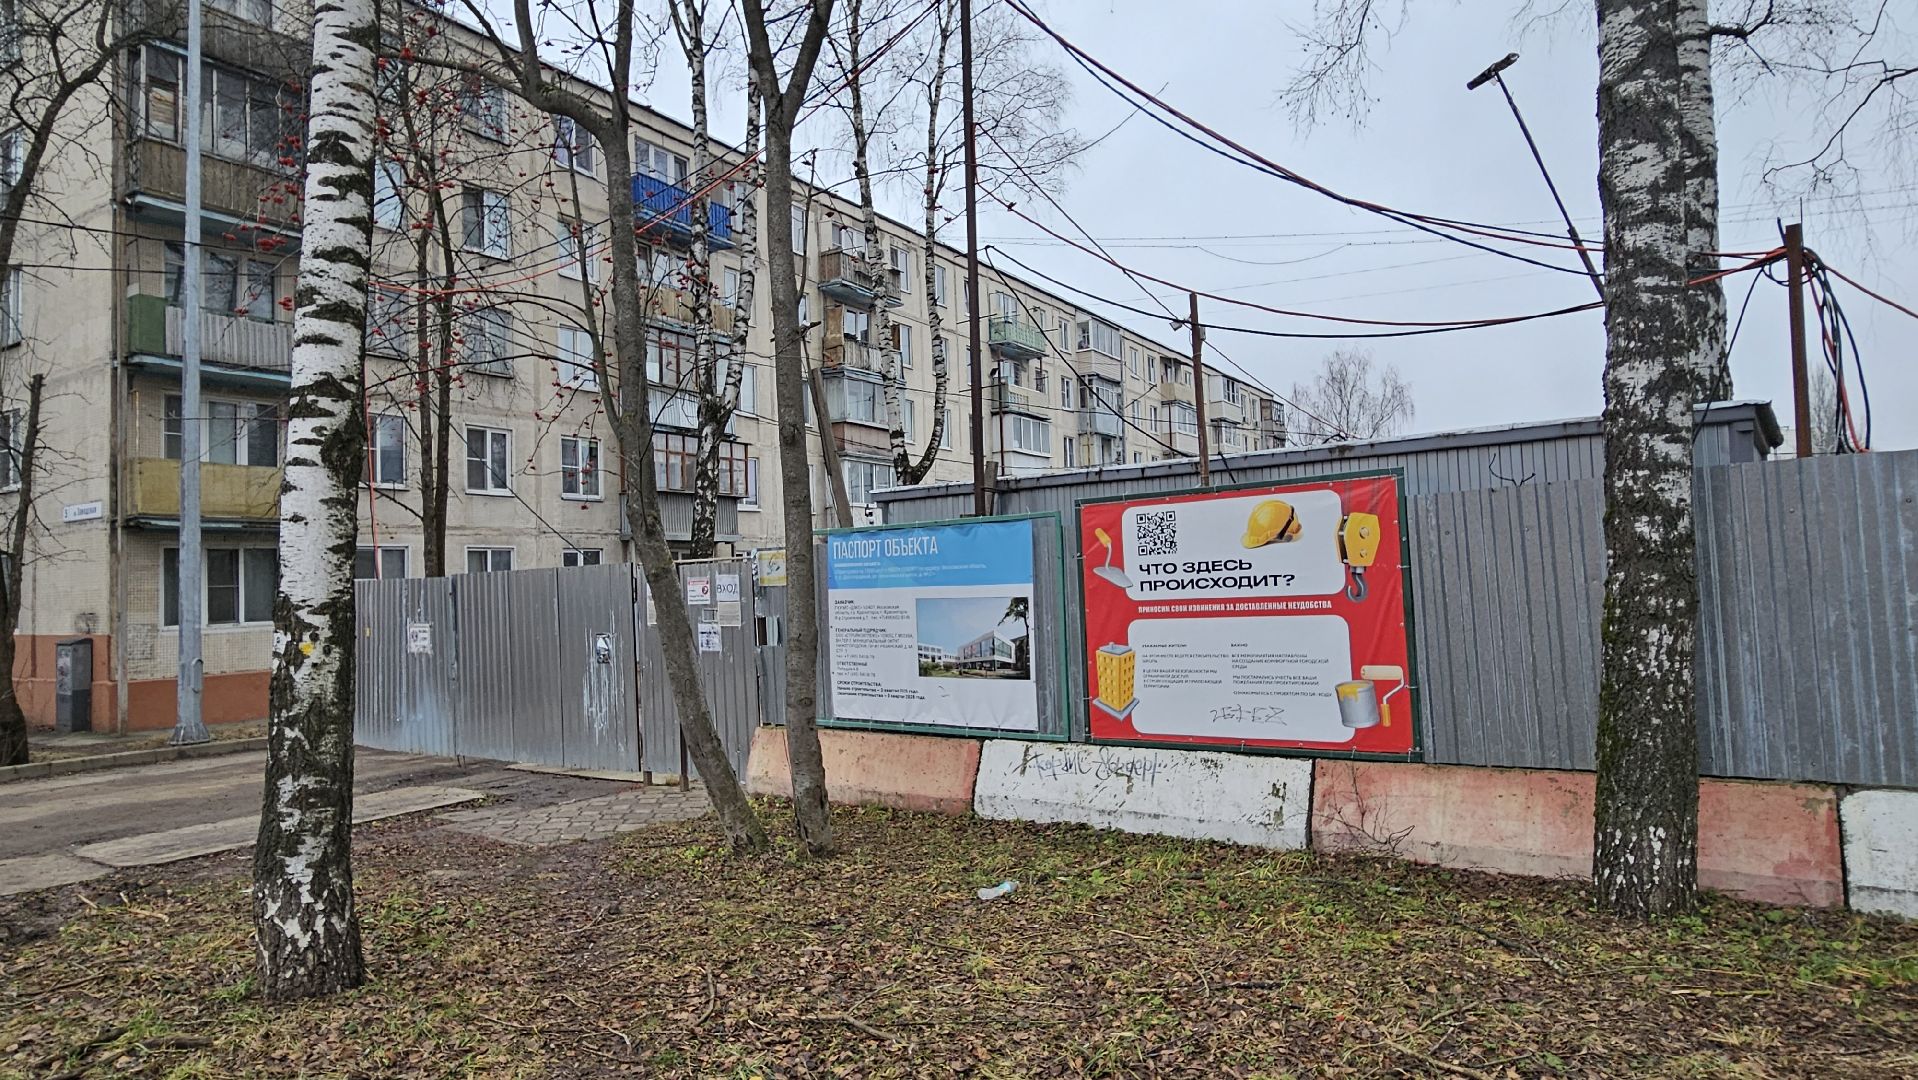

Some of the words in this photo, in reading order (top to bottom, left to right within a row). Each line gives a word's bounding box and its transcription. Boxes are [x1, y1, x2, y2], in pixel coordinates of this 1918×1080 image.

[833, 539, 881, 559] ПАСПОРТ
[884, 536, 938, 557] ОБЪЕКТА
[1138, 562, 1177, 575] ЧТО
[1182, 559, 1252, 575] ЗДЕСЬ
[1140, 574, 1295, 592] ПРОИСХОДИТ?
[1138, 605, 1170, 613] ПРИНОСИМ
[1171, 604, 1188, 612] СВОИ
[1188, 604, 1225, 612] ИЗВИНЕНИЯ
[1235, 602, 1286, 610] ДОСТАВЛЕННЫЕ
[1288, 600, 1332, 610] НЕУДОБСТВА
